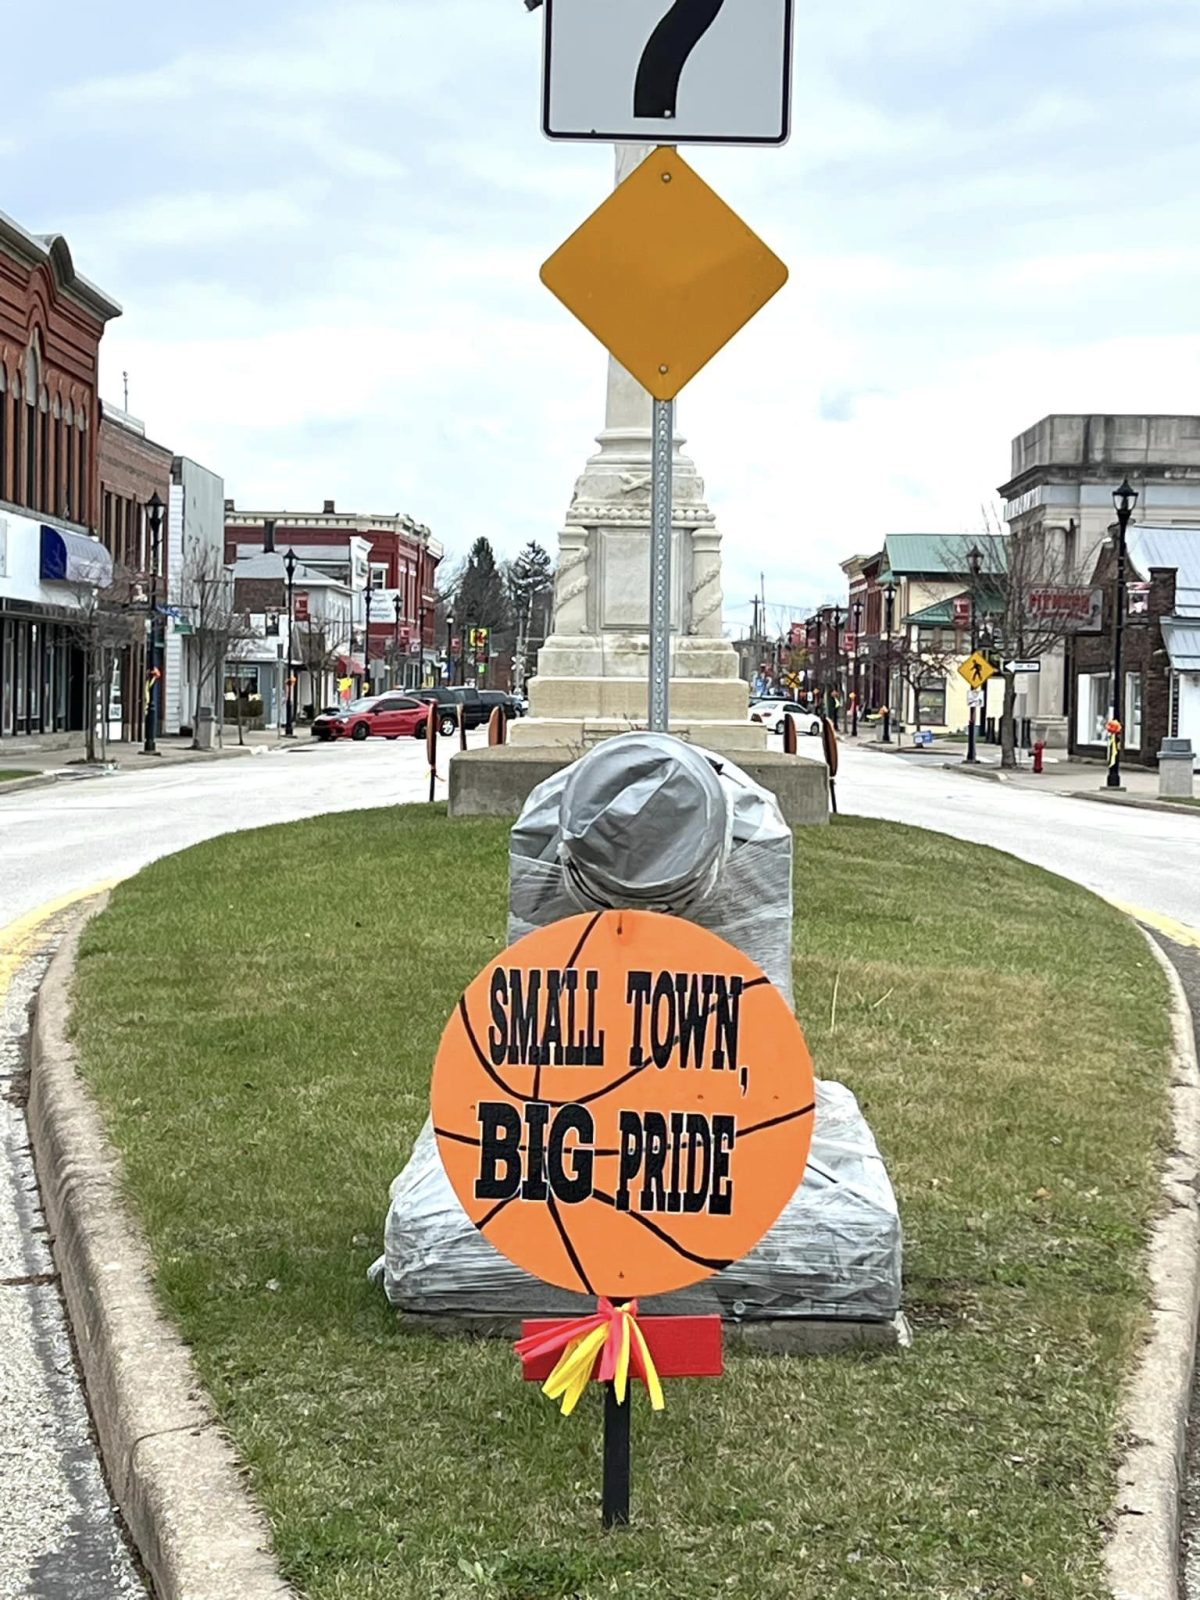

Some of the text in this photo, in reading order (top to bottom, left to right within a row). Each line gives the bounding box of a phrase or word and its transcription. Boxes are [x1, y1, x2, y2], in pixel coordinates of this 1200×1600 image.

[489, 967, 748, 1097] SMALL TOWN,
[475, 1102, 735, 1215] BIG PRIDE
